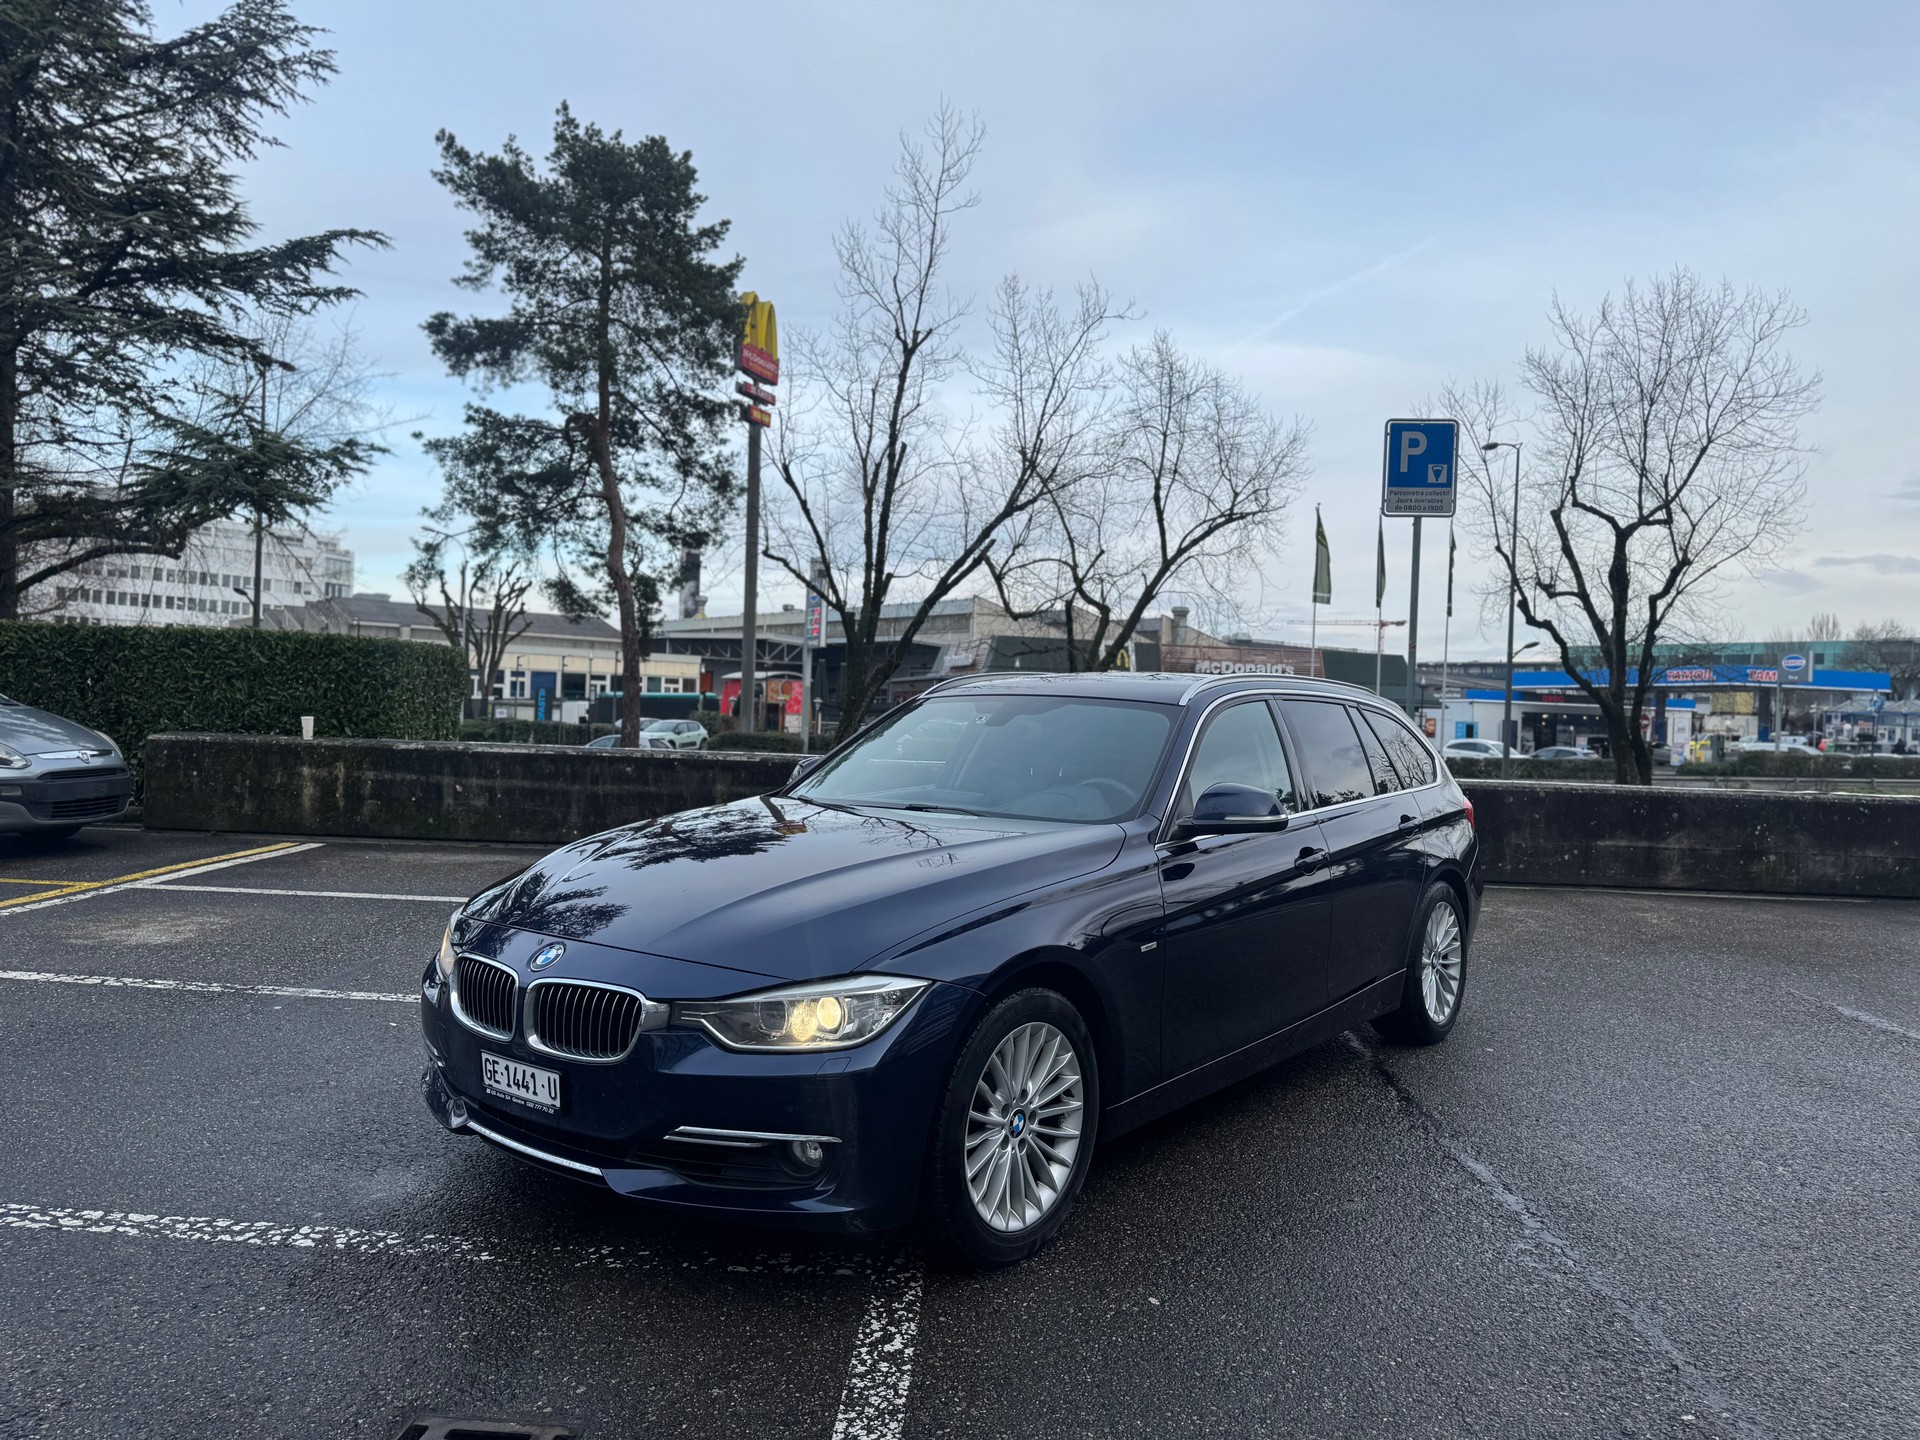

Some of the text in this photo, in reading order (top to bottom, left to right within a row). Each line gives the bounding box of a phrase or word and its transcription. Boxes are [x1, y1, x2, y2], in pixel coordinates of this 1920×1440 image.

[1400, 431, 1427, 472] P
[1195, 660, 1295, 675] McDonald's
[1666, 669, 1716, 681] TAMOIL
[1746, 669, 1778, 681] TAM
